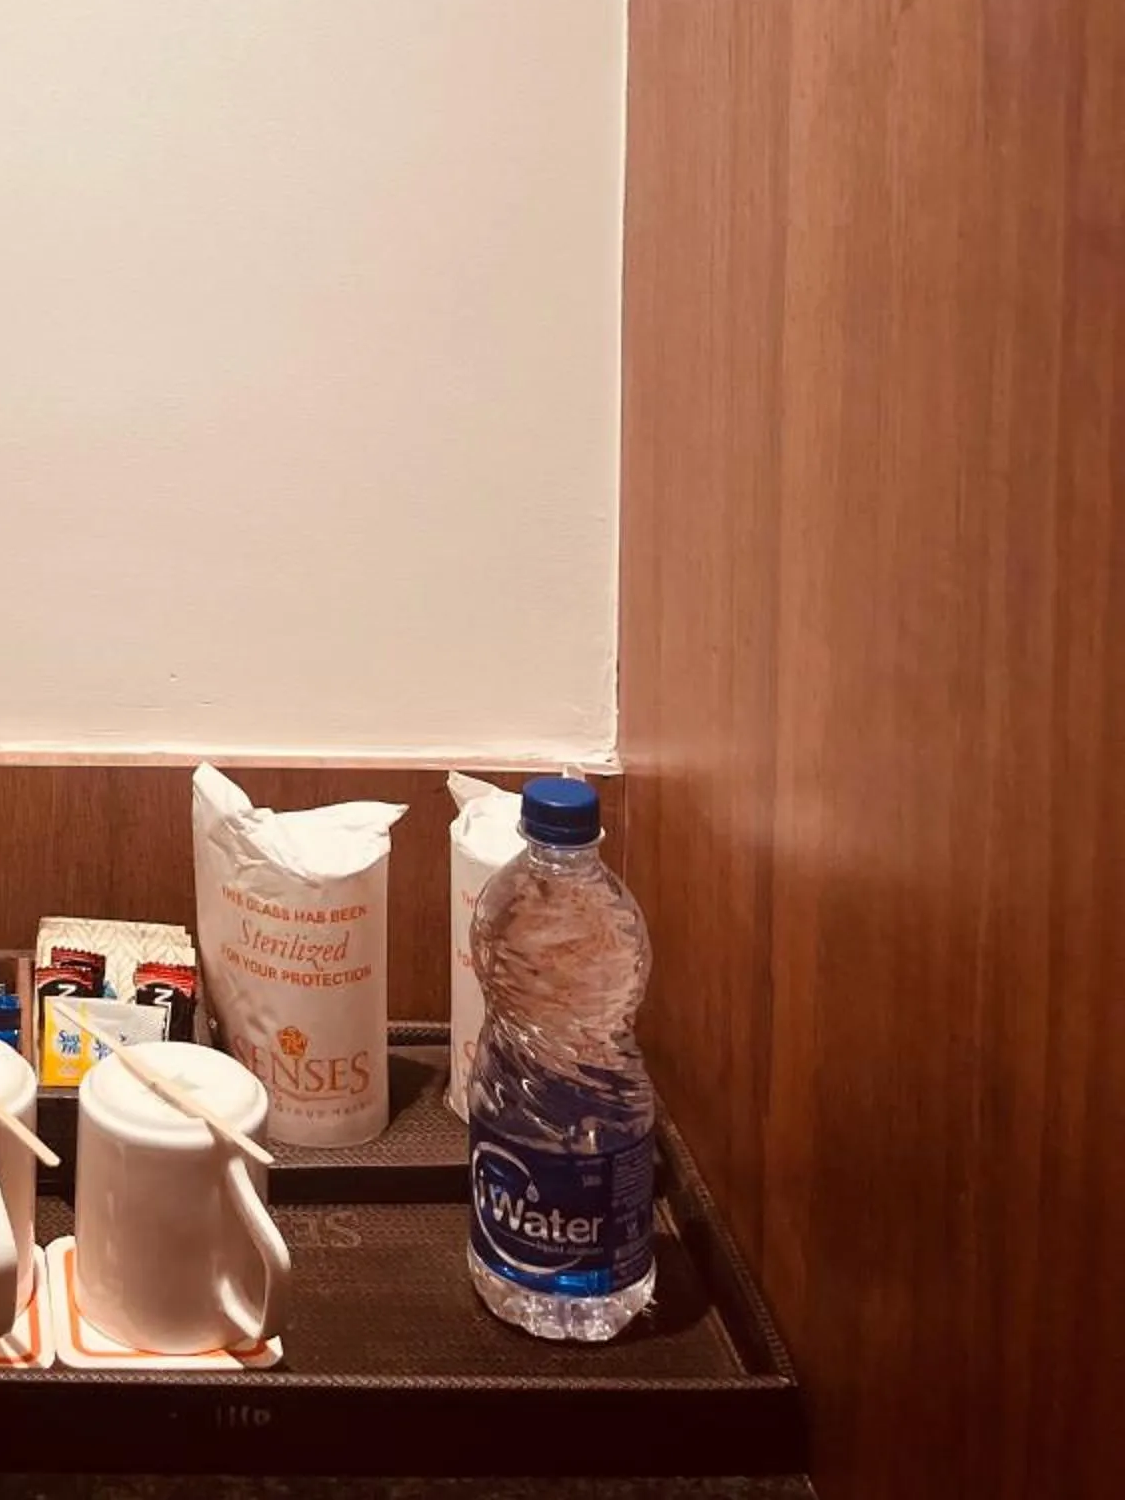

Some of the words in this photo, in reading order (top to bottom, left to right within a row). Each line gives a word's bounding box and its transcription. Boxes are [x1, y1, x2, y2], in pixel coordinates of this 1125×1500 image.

[246, 896, 290, 922] GLASS
[294, 908, 327, 924] HAS
[330, 903, 367, 923] BEEN
[239, 918, 350, 973] Sterilized
[242, 955, 278, 980] YOUR
[281, 964, 372, 987] PROTECTION
